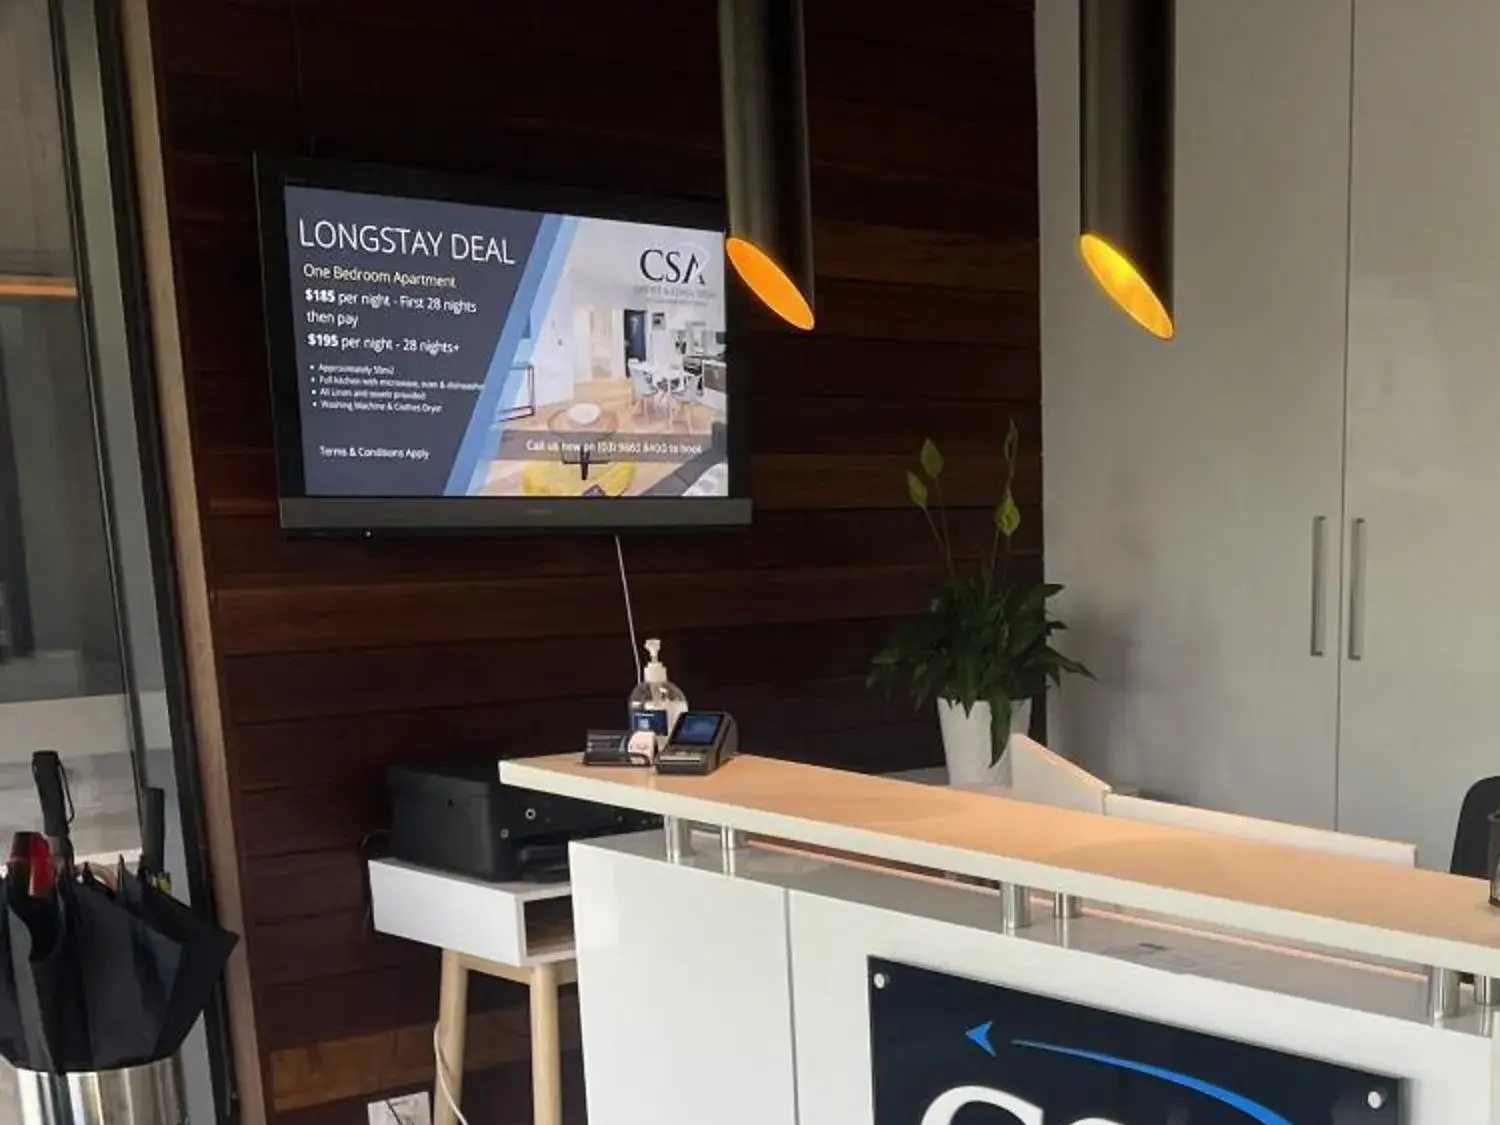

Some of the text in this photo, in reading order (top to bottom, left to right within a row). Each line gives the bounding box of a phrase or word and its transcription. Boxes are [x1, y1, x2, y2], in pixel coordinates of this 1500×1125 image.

[299, 218, 516, 265] LONGSTAY DEAL
[303, 263, 457, 289] One Bedroom Apartment
[640, 248, 706, 285] CSA
[305, 288, 336, 303] $185
[338, 292, 358, 306] per
[361, 294, 390, 309] night
[400, 295, 424, 309] First
[426, 297, 441, 310] 28
[443, 299, 477, 315] nights
[306, 310, 359, 329] then pay
[307, 333, 339, 347] $195
[341, 337, 361, 351] per
[363, 337, 393, 353] night
[403, 339, 417, 351] 28
[319, 445, 347, 457] Terms
[349, 447, 357, 457] &
[405, 447, 431, 461] Apply
